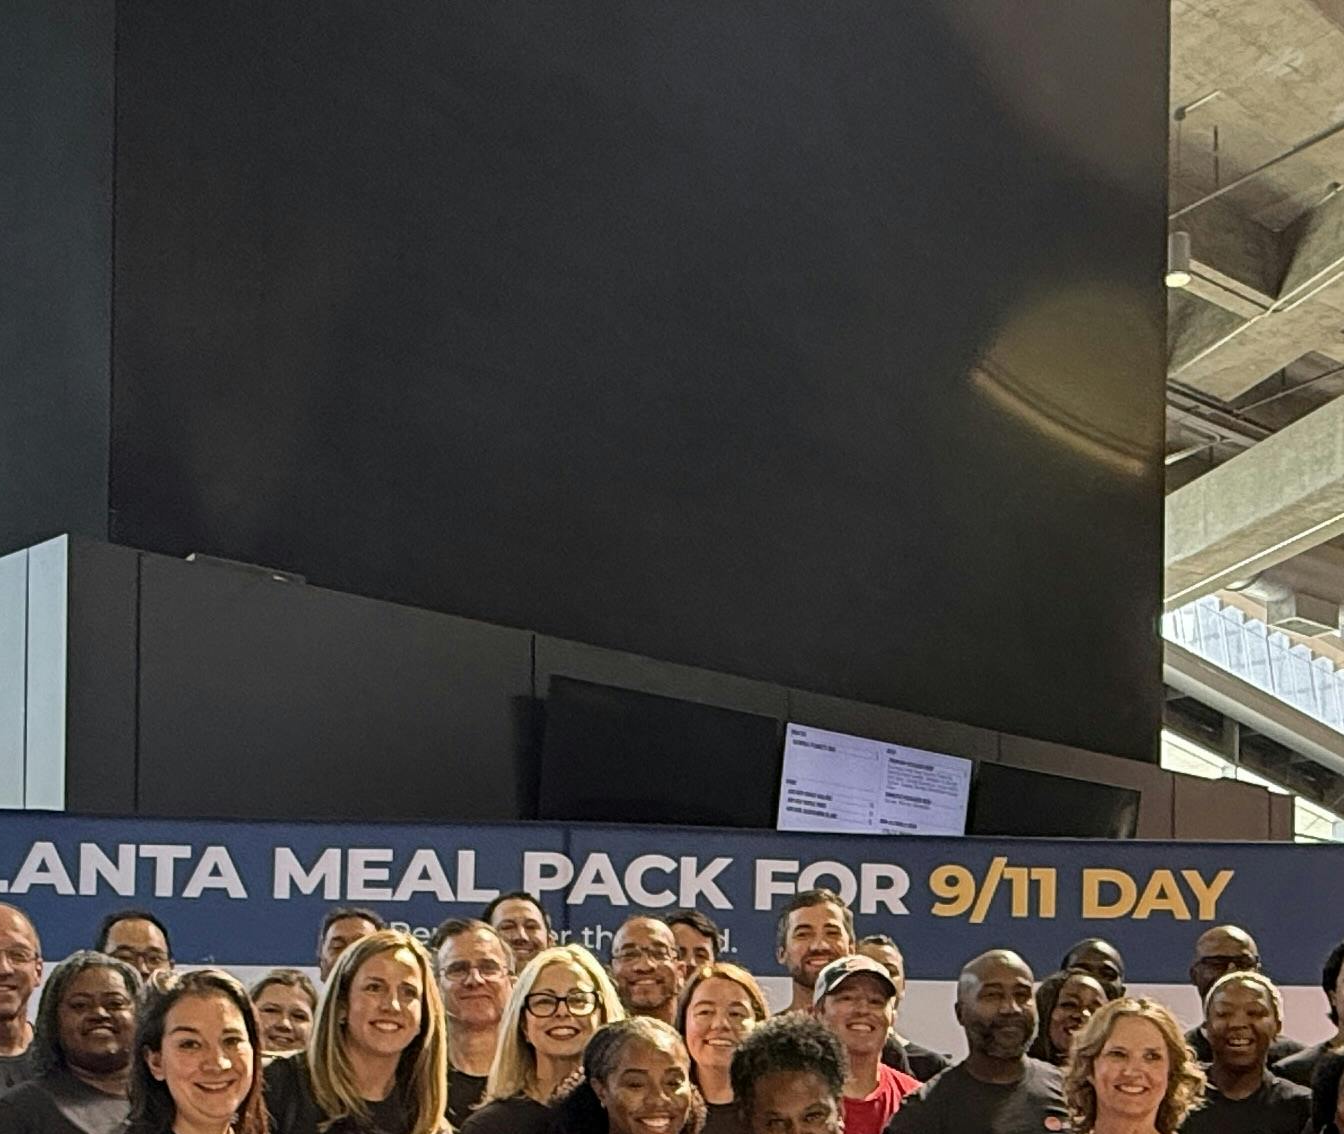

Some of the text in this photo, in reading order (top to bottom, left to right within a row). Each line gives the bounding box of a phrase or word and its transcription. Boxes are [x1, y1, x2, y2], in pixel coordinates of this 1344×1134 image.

[274, 847, 500, 902] MEAL
[523, 851, 733, 910] PACK
[754, 858, 910, 915] FOR
[929, 855, 1056, 923] 9/11
[1082, 867, 1234, 920] DAY
